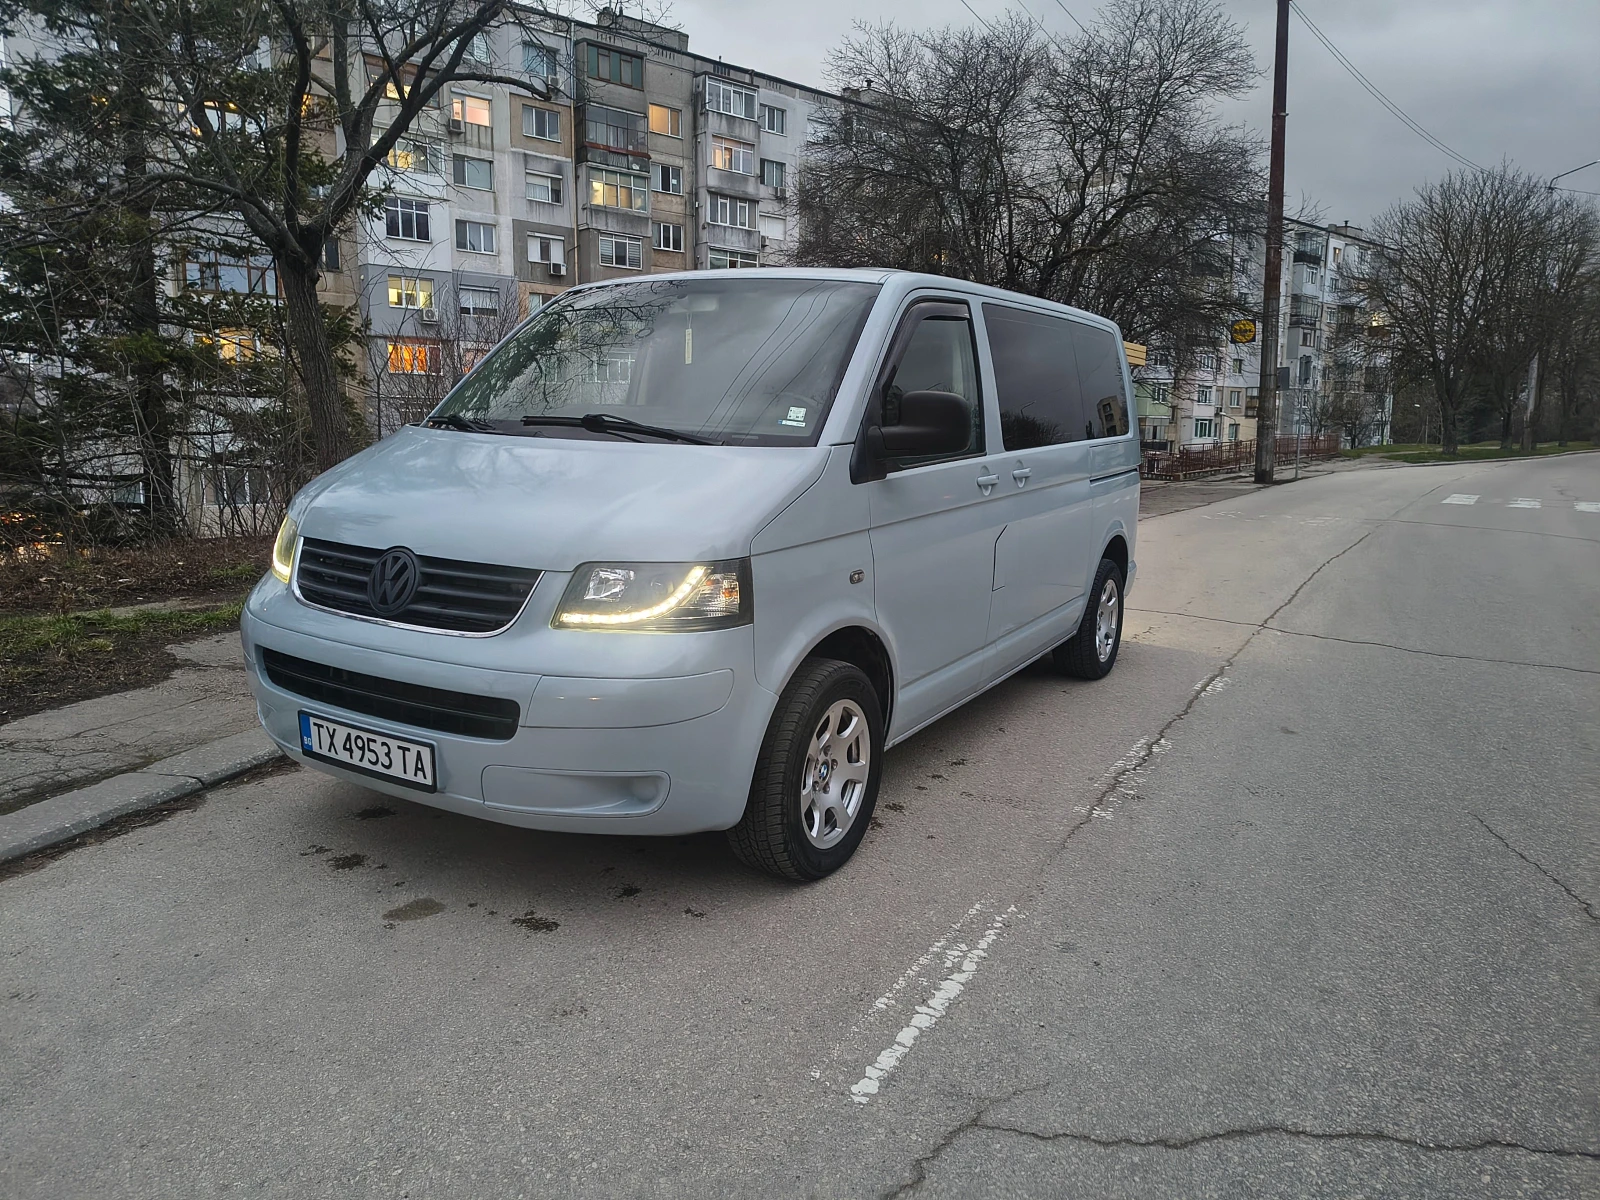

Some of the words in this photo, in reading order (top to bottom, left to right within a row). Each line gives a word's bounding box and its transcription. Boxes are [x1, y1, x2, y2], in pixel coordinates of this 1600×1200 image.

[372, 550, 414, 609] VW
[303, 735, 312, 746] BG
[312, 722, 338, 755] TX
[342, 732, 393, 770] 4953
[397, 745, 427, 779] TA
